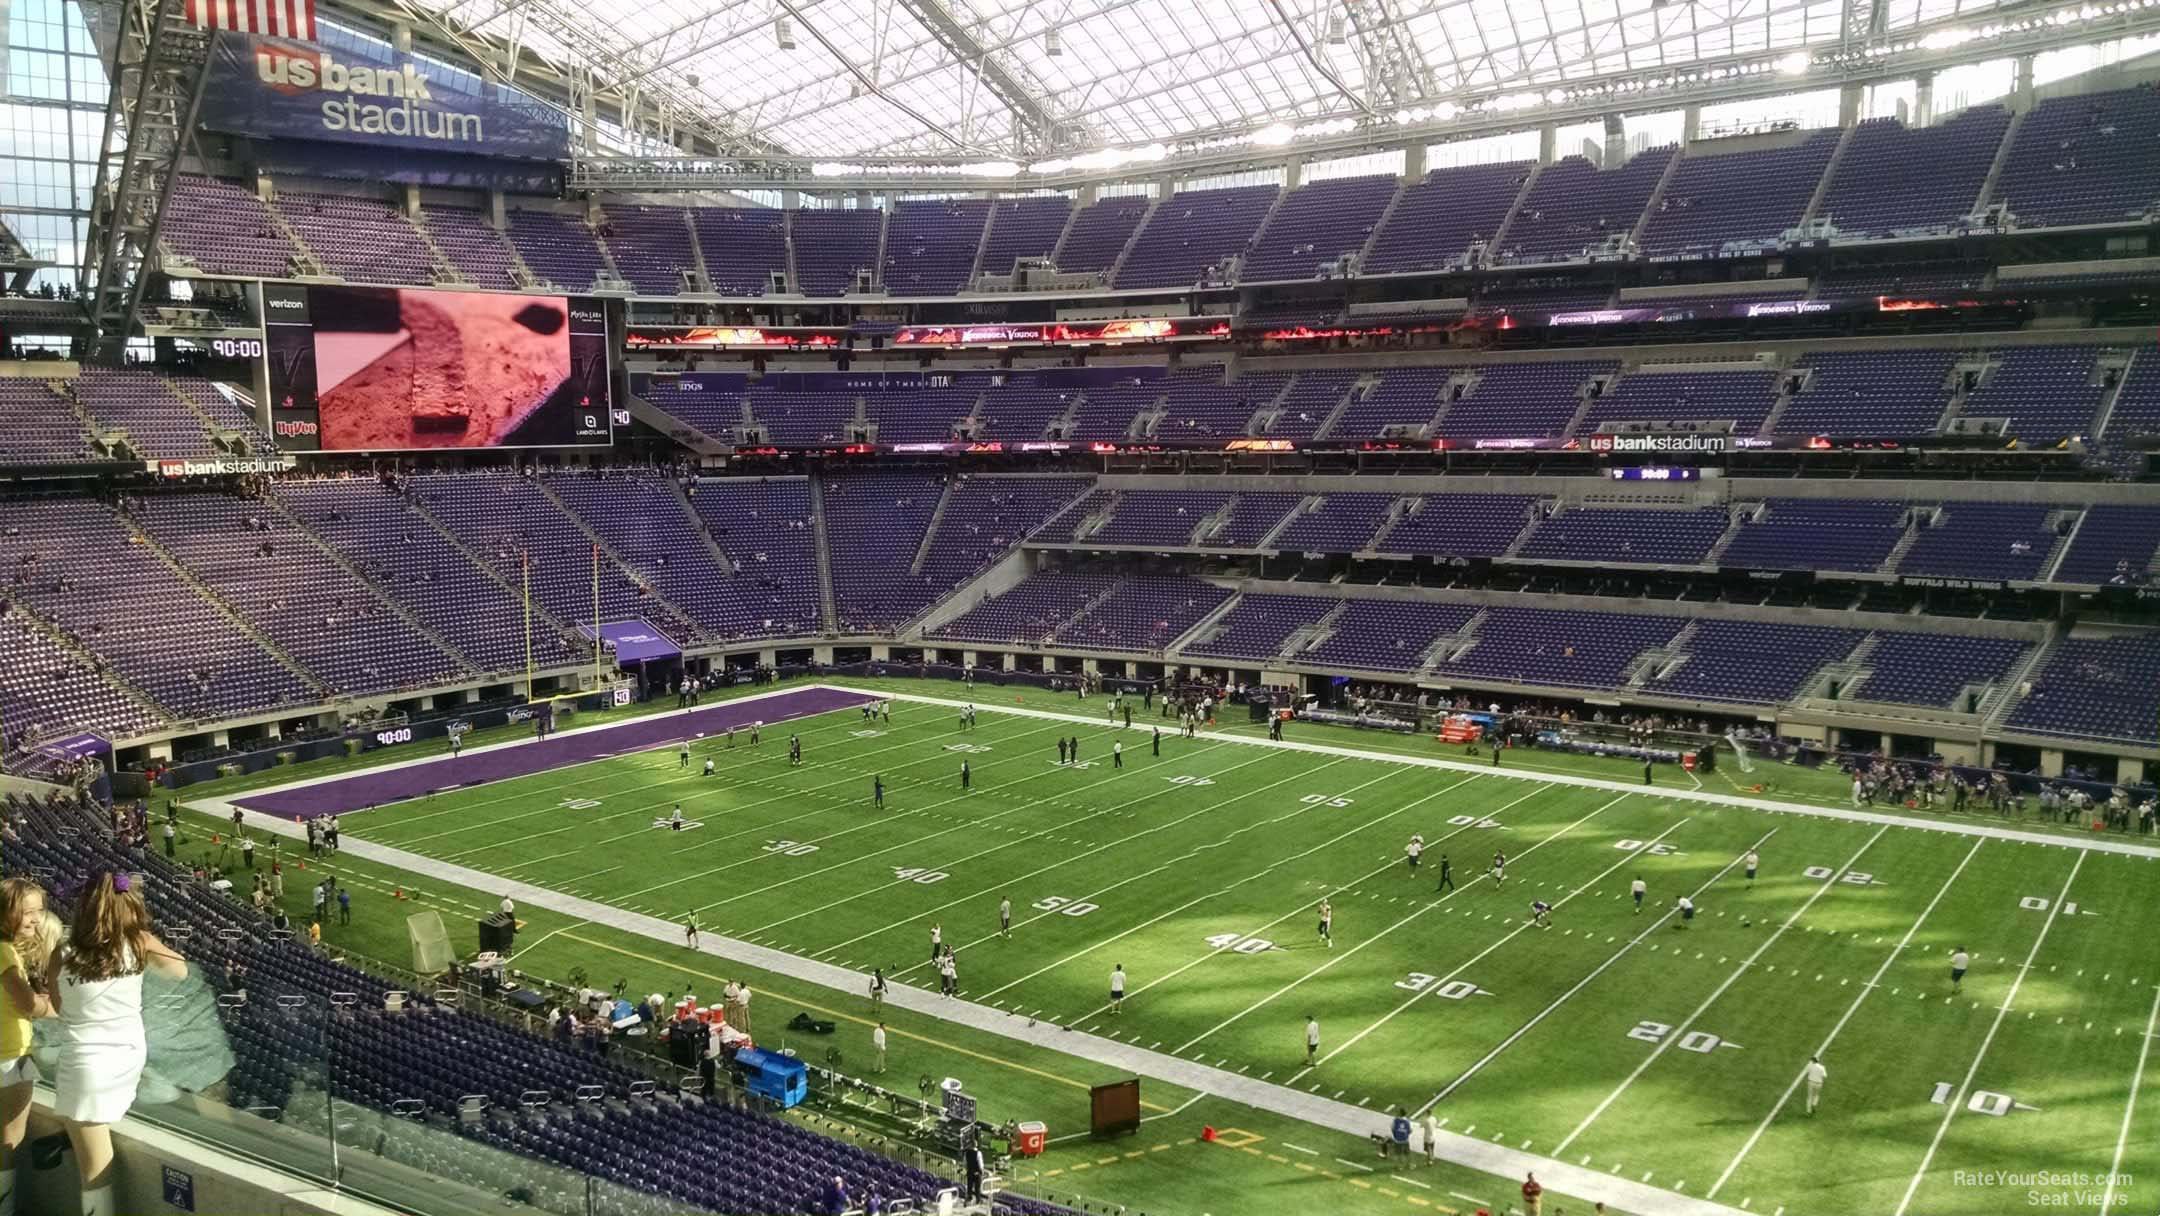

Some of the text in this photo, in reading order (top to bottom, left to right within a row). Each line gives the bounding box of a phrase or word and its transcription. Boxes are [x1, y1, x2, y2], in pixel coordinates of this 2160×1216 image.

[322, 96, 483, 142] stadium
[269, 299, 303, 309] verizon
[212, 340, 262, 357] 90:00
[613, 410, 630, 424] 40
[1903, 577, 1945, 587] BUFFALO
[1947, 579, 1969, 588] WILD
[377, 728, 411, 745] 90:00
[1031, 896, 1100, 916] 50
[1205, 933, 1273, 954] 40
[1394, 972, 1477, 999] 30
[1627, 1021, 1720, 1053] 20
[1930, 1082, 2012, 1116] 10
[1028, 1135, 1040, 1148] G
